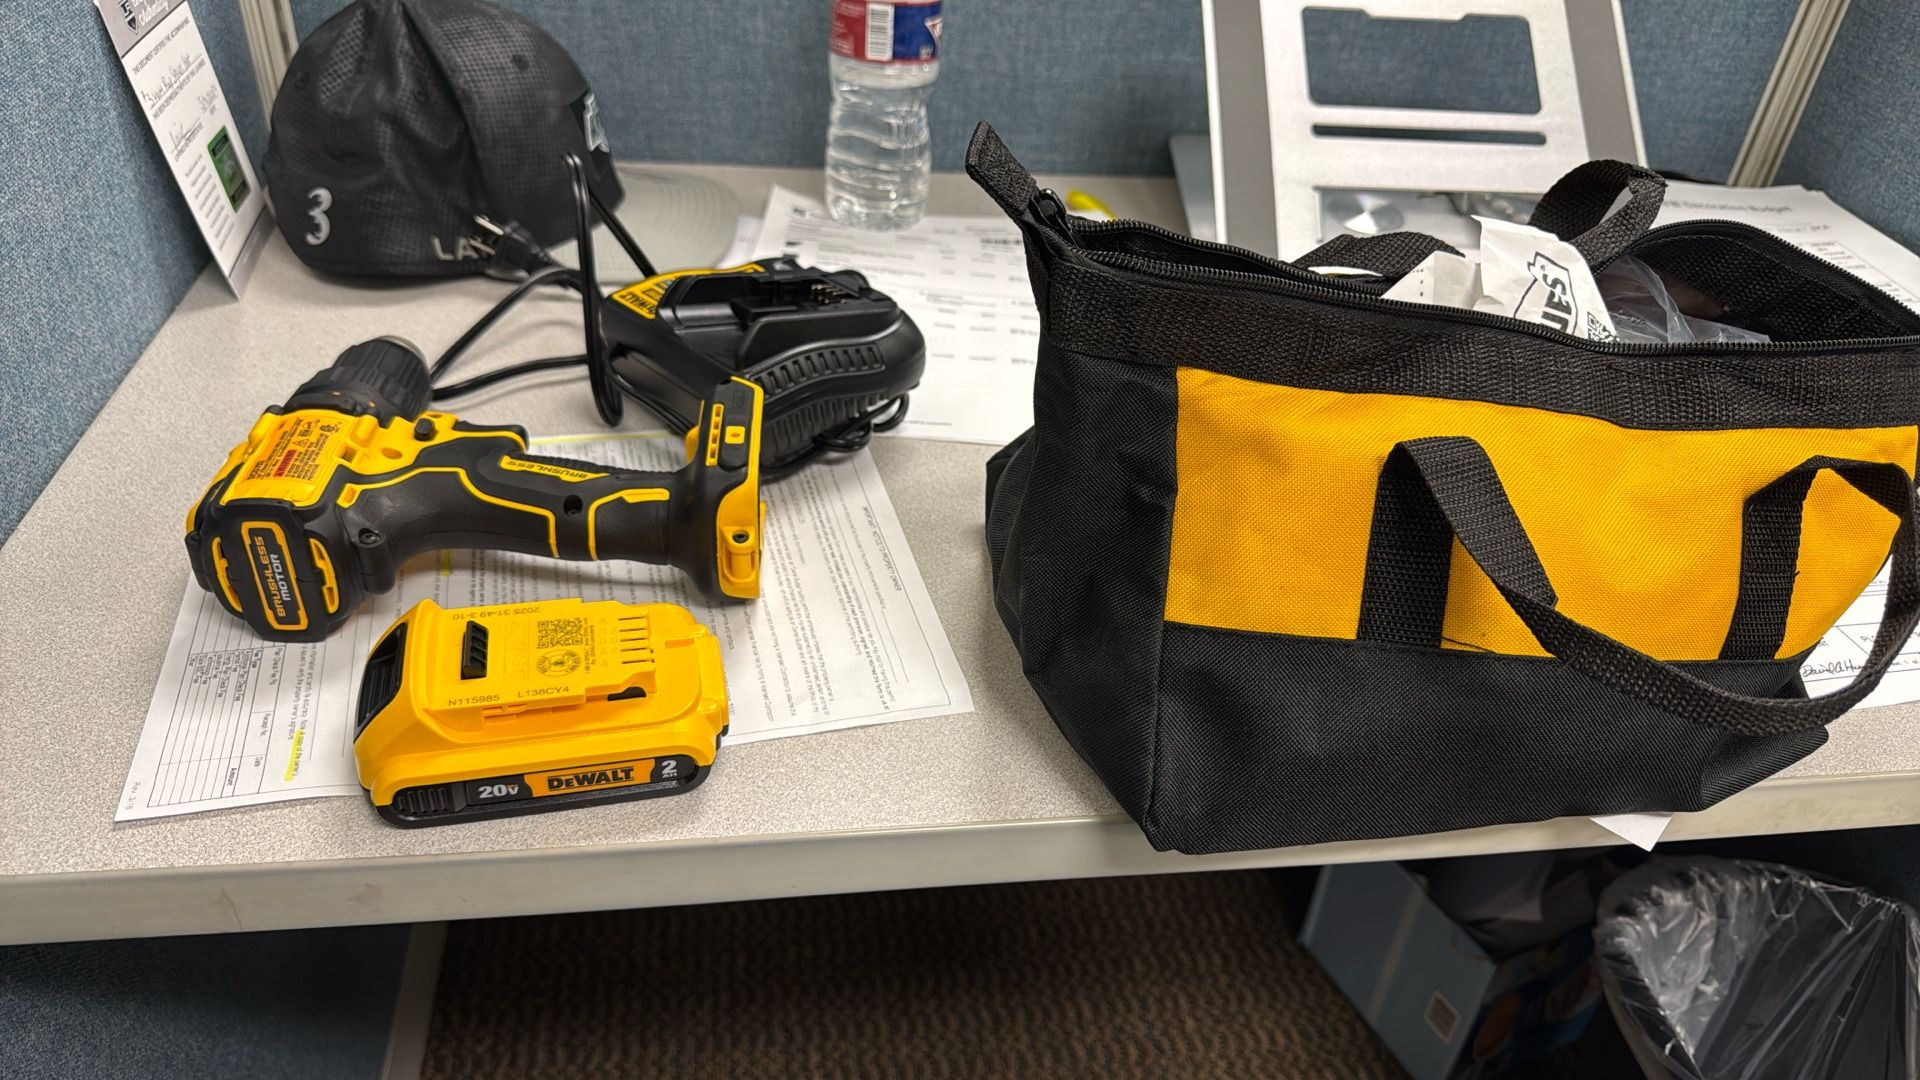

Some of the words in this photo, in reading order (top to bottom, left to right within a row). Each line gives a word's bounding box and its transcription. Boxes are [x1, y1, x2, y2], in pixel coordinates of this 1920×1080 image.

[305, 187, 333, 245] 3
[506, 459, 588, 479] BRUSHLESS
[254, 535, 286, 618] BRUSHLESS
[270, 553, 291, 602] MOTOR
[448, 693, 501, 707] N115985
[517, 686, 570, 699] L138CY4
[661, 759, 677, 774] 2
